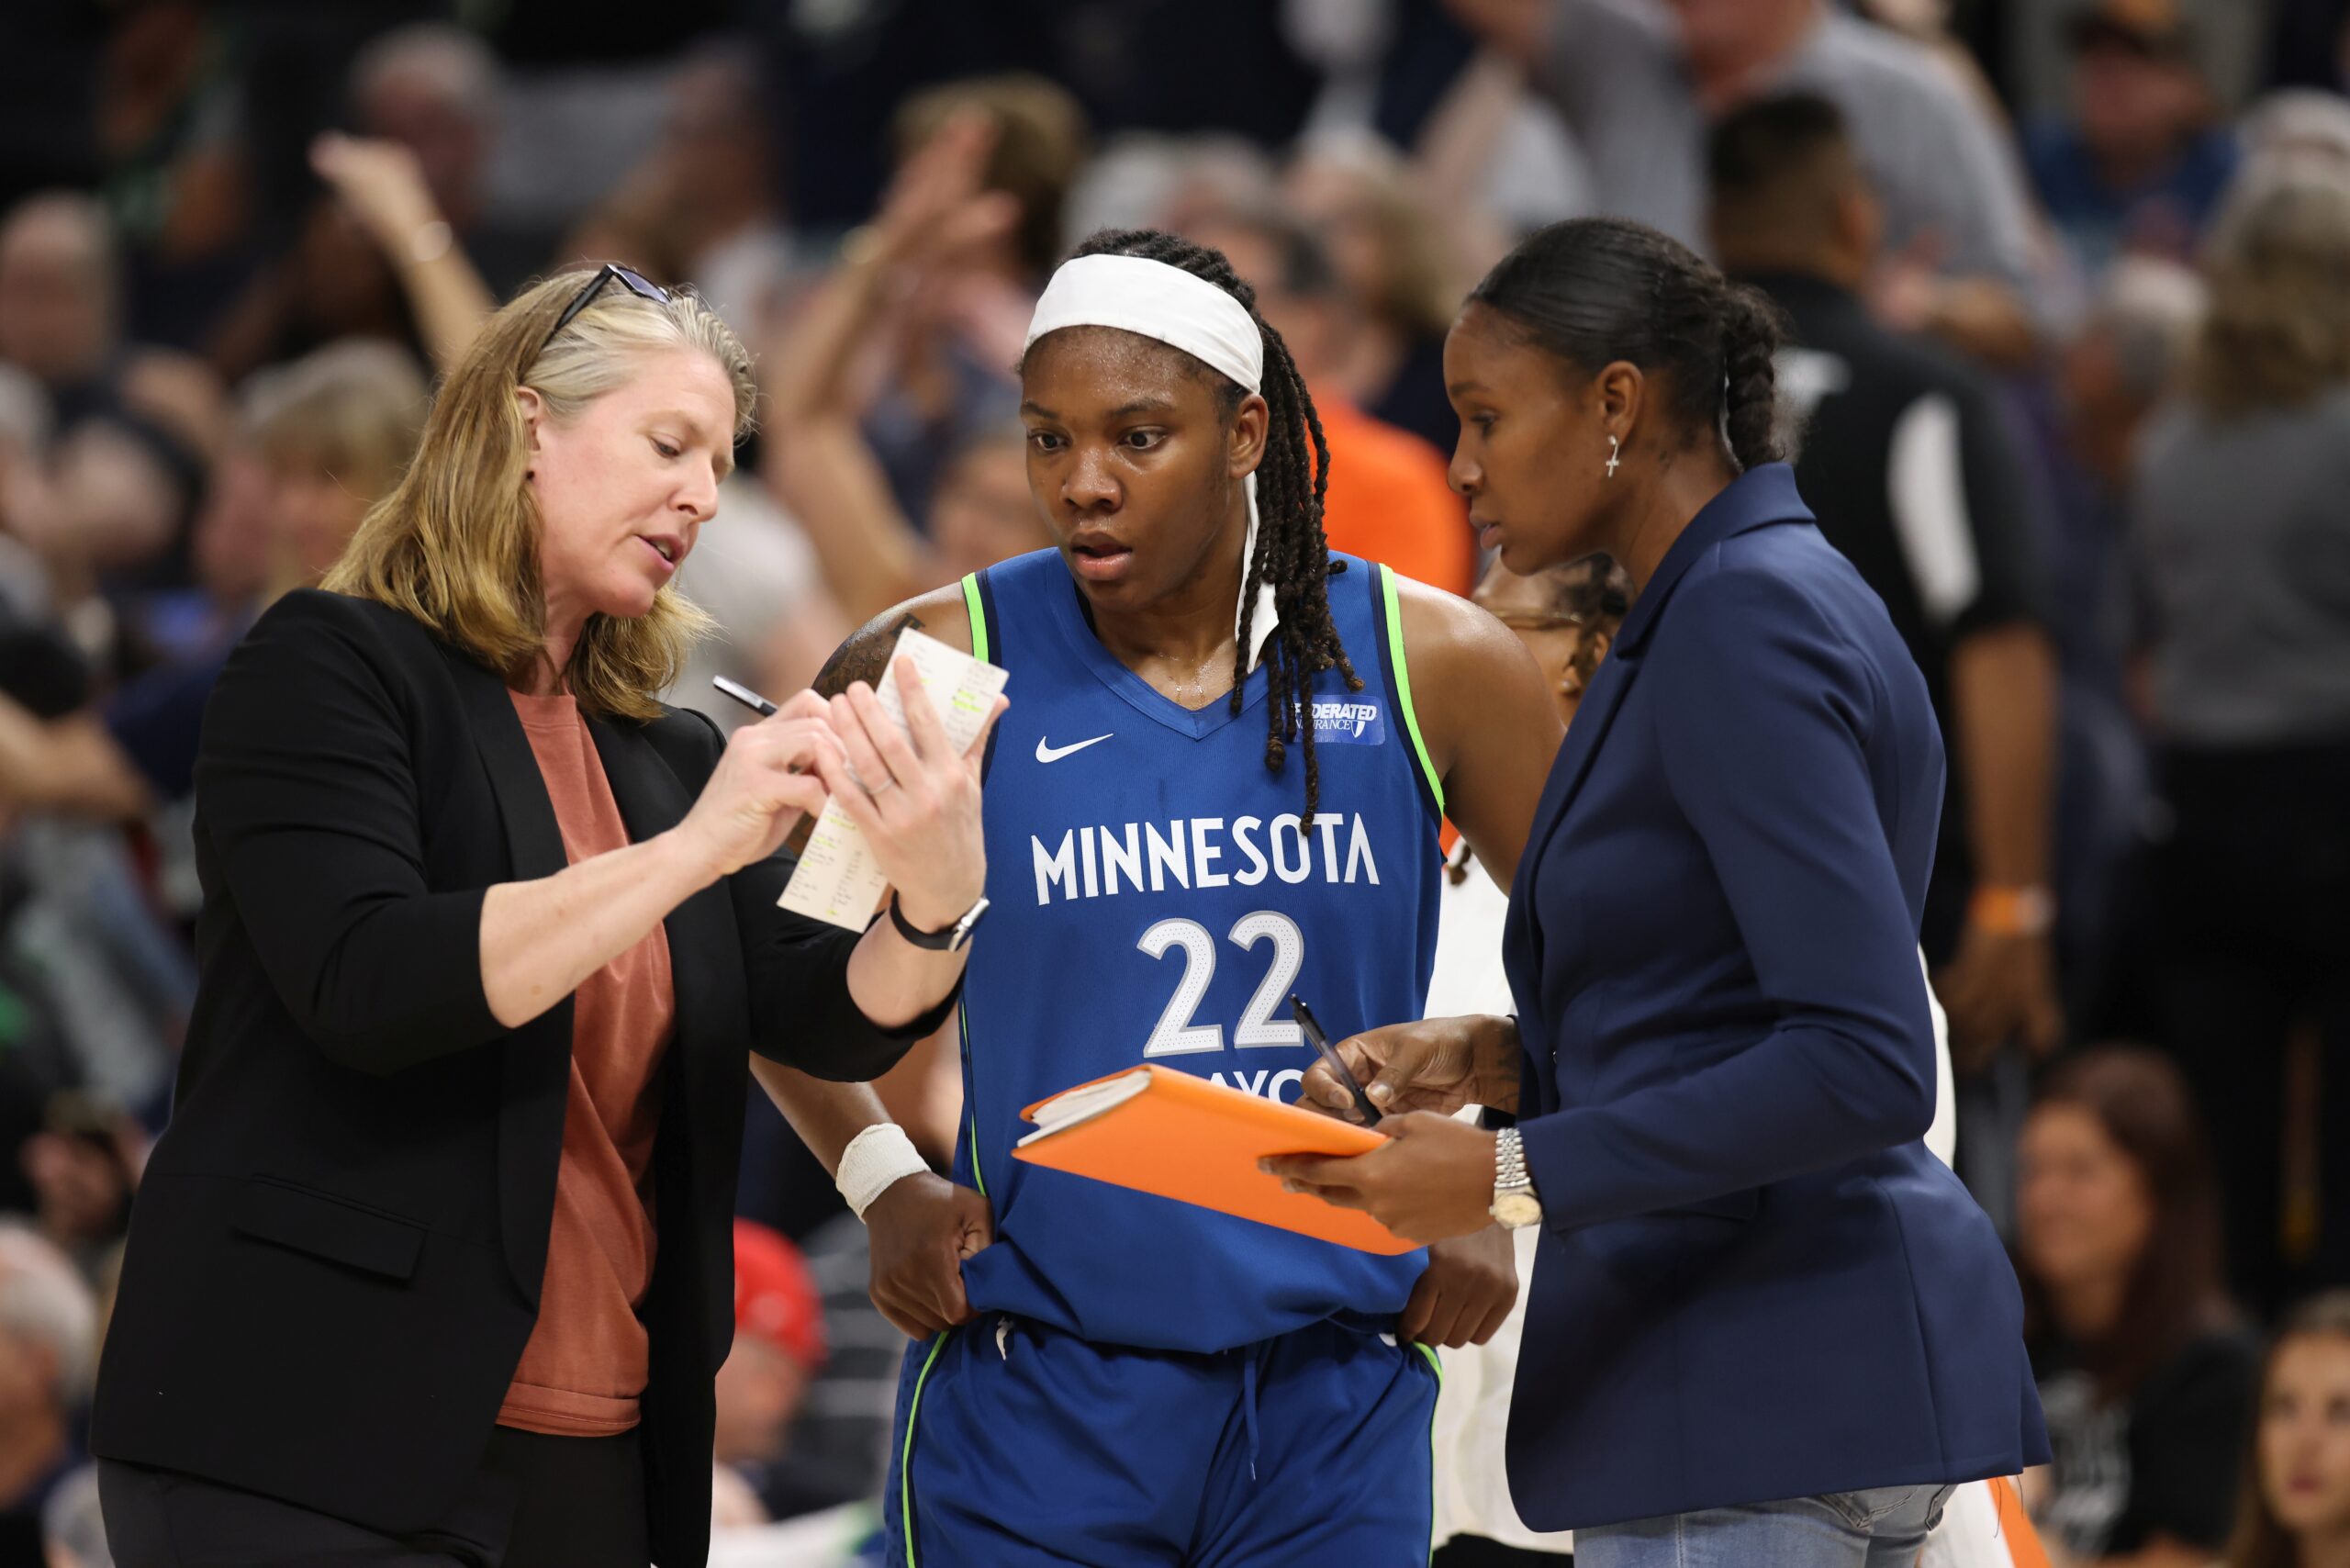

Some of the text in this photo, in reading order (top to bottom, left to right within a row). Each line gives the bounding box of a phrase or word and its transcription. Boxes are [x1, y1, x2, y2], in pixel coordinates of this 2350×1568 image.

[1294, 703, 1377, 721] FDERATED
[1031, 812, 1381, 905] MINNESOTA
[1136, 910, 1304, 1058] 22
